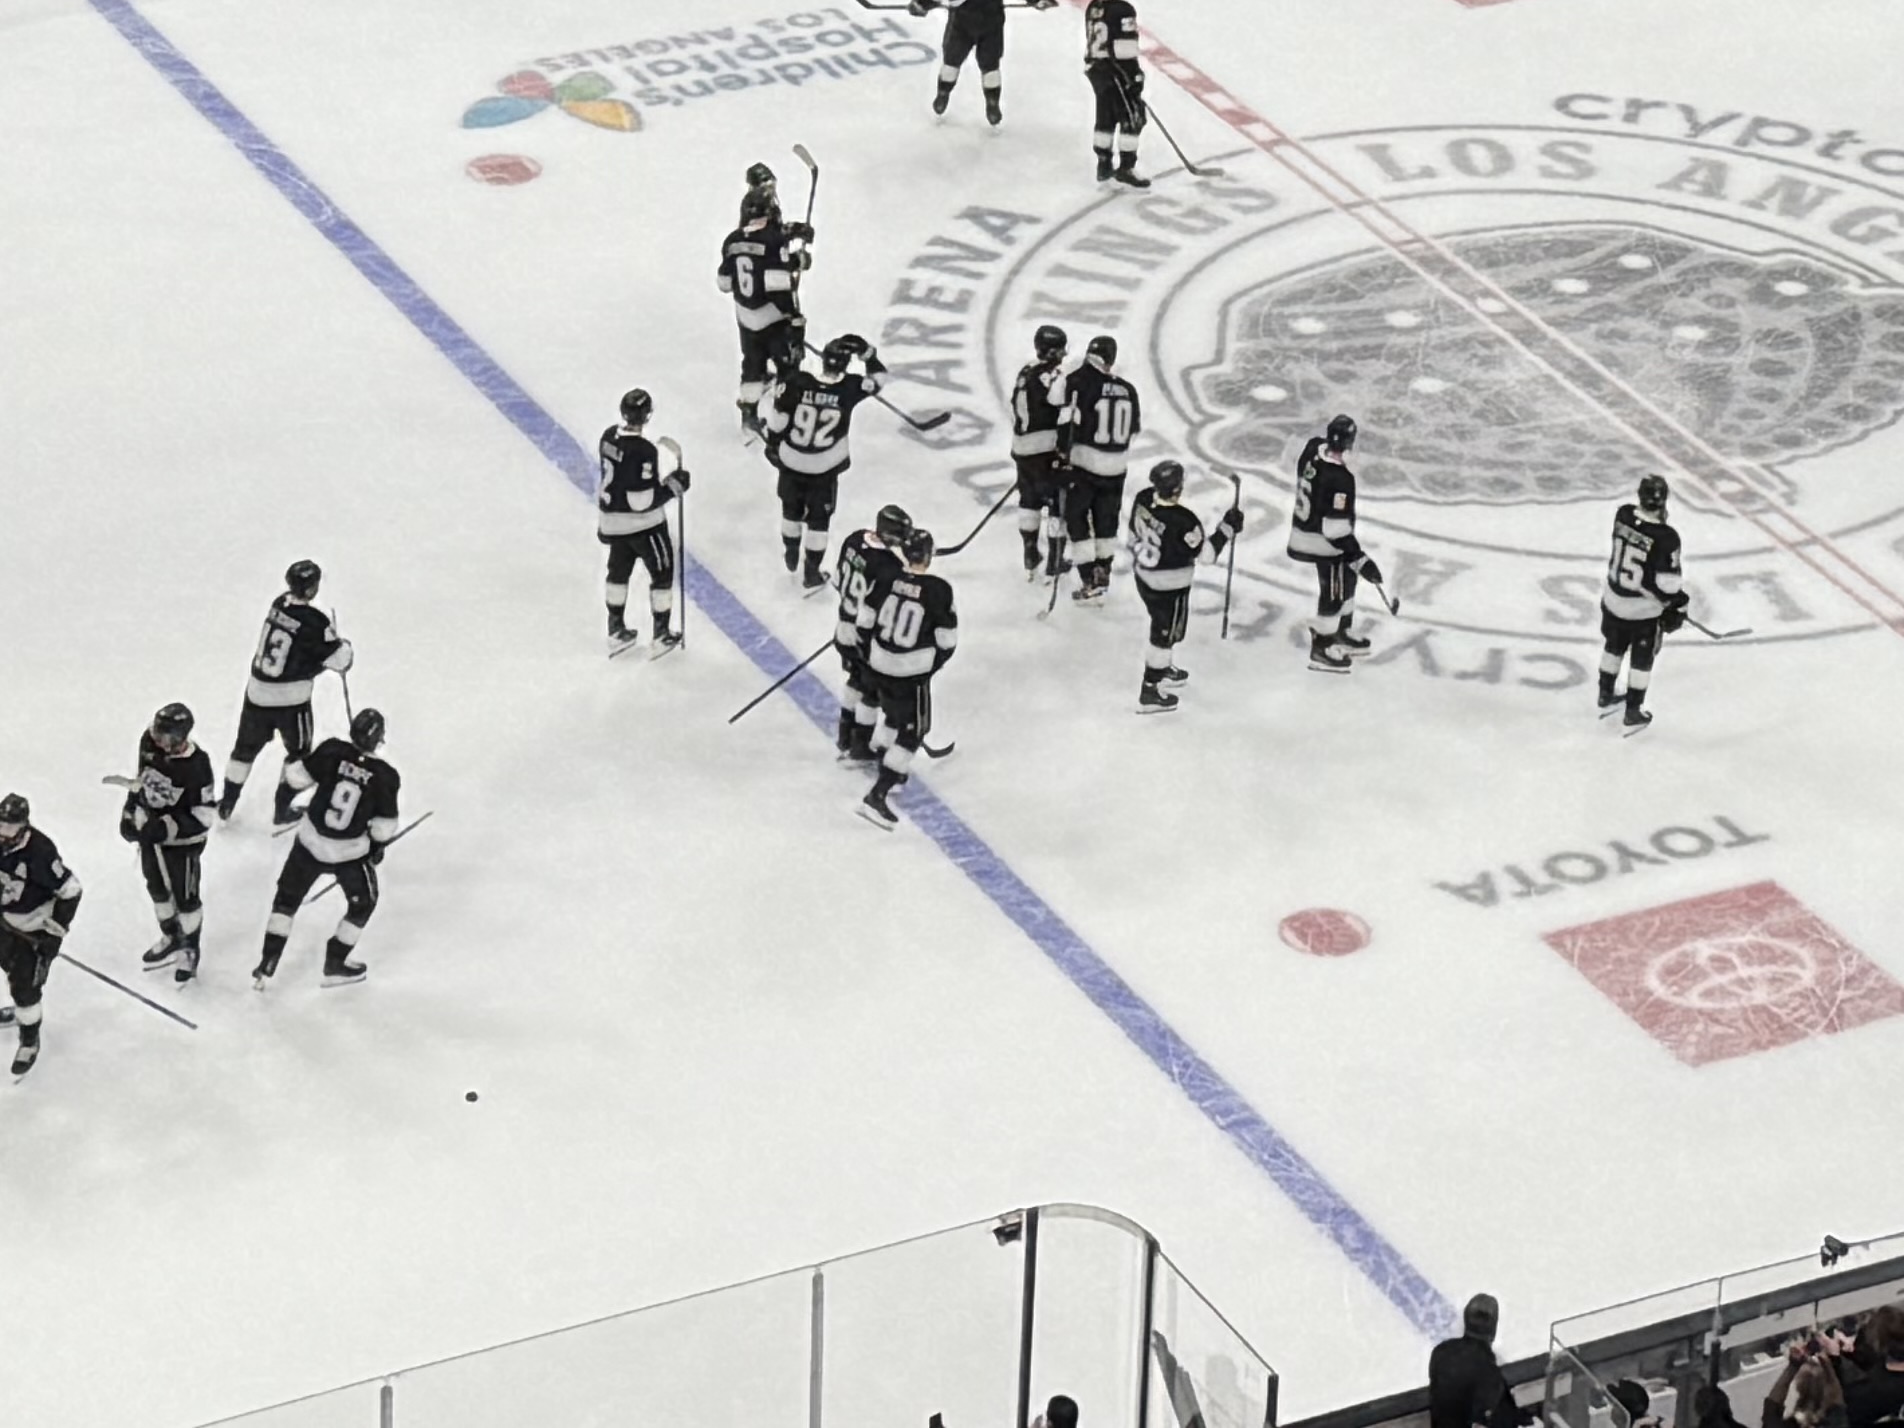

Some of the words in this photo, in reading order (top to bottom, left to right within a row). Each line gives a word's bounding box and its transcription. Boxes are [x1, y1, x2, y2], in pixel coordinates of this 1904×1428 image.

[626, 15, 911, 86] Hospital
[630, 40, 939, 108] Children's
[1018, 178, 1280, 331] KINGS
[1355, 135, 1598, 188] LOS
[735, 255, 754, 298] 6
[881, 204, 1044, 395] ARENA
[789, 403, 841, 448] 92
[1093, 398, 1132, 445] 10
[1612, 538, 1648, 591] 15
[877, 593, 925, 648] 40
[254, 621, 294, 679] 13
[324, 780, 363, 832] 9
[1434, 814, 1771, 908] TOYOTA
